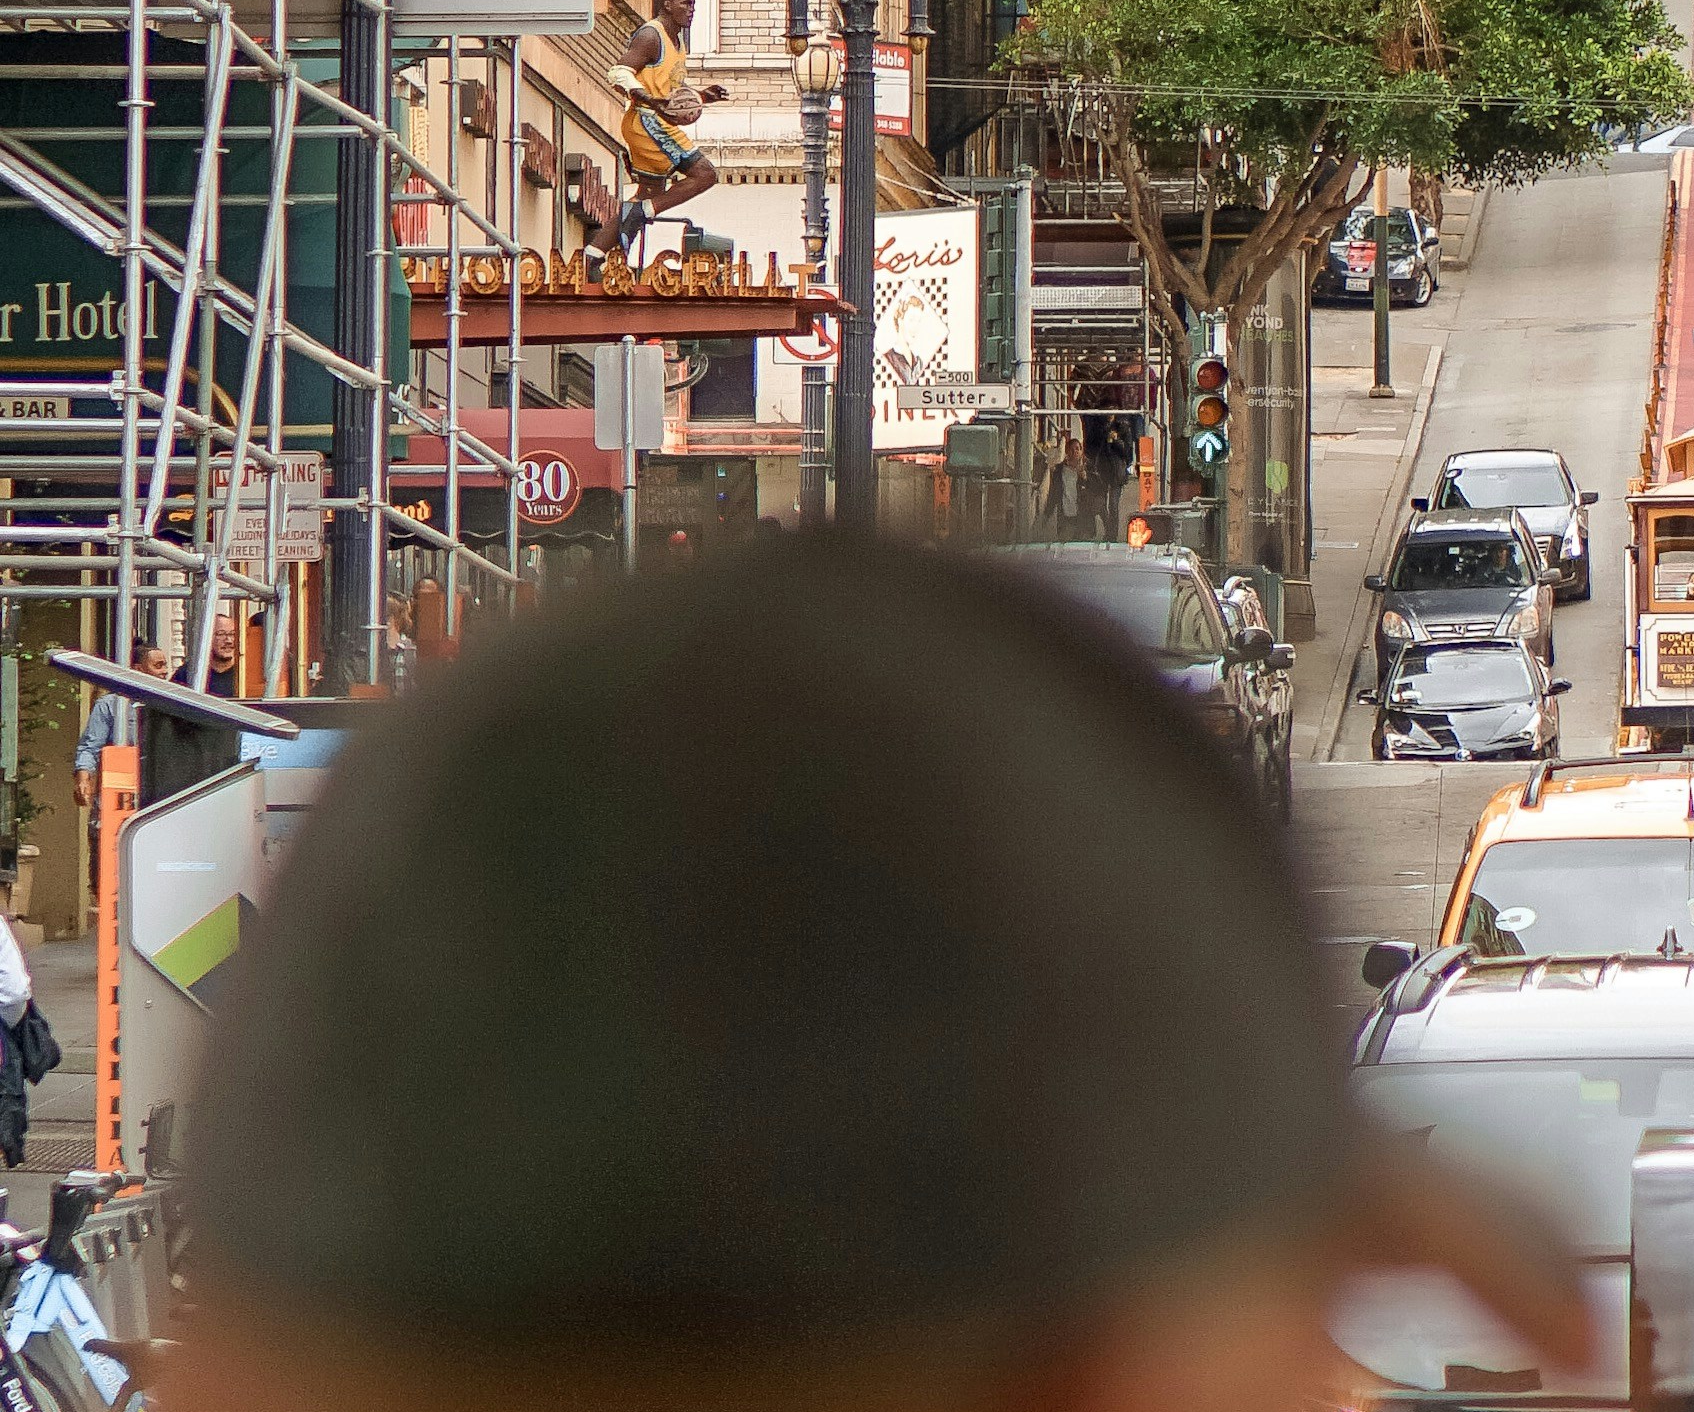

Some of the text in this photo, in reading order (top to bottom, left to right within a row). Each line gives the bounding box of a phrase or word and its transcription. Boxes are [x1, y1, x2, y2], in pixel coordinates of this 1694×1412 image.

[652, 249, 792, 297] GRILL
[922, 390, 986, 404] Sutter
[13, 401, 58, 418] BAR
[517, 460, 571, 503] 80
[526, 502, 562, 516] Years
